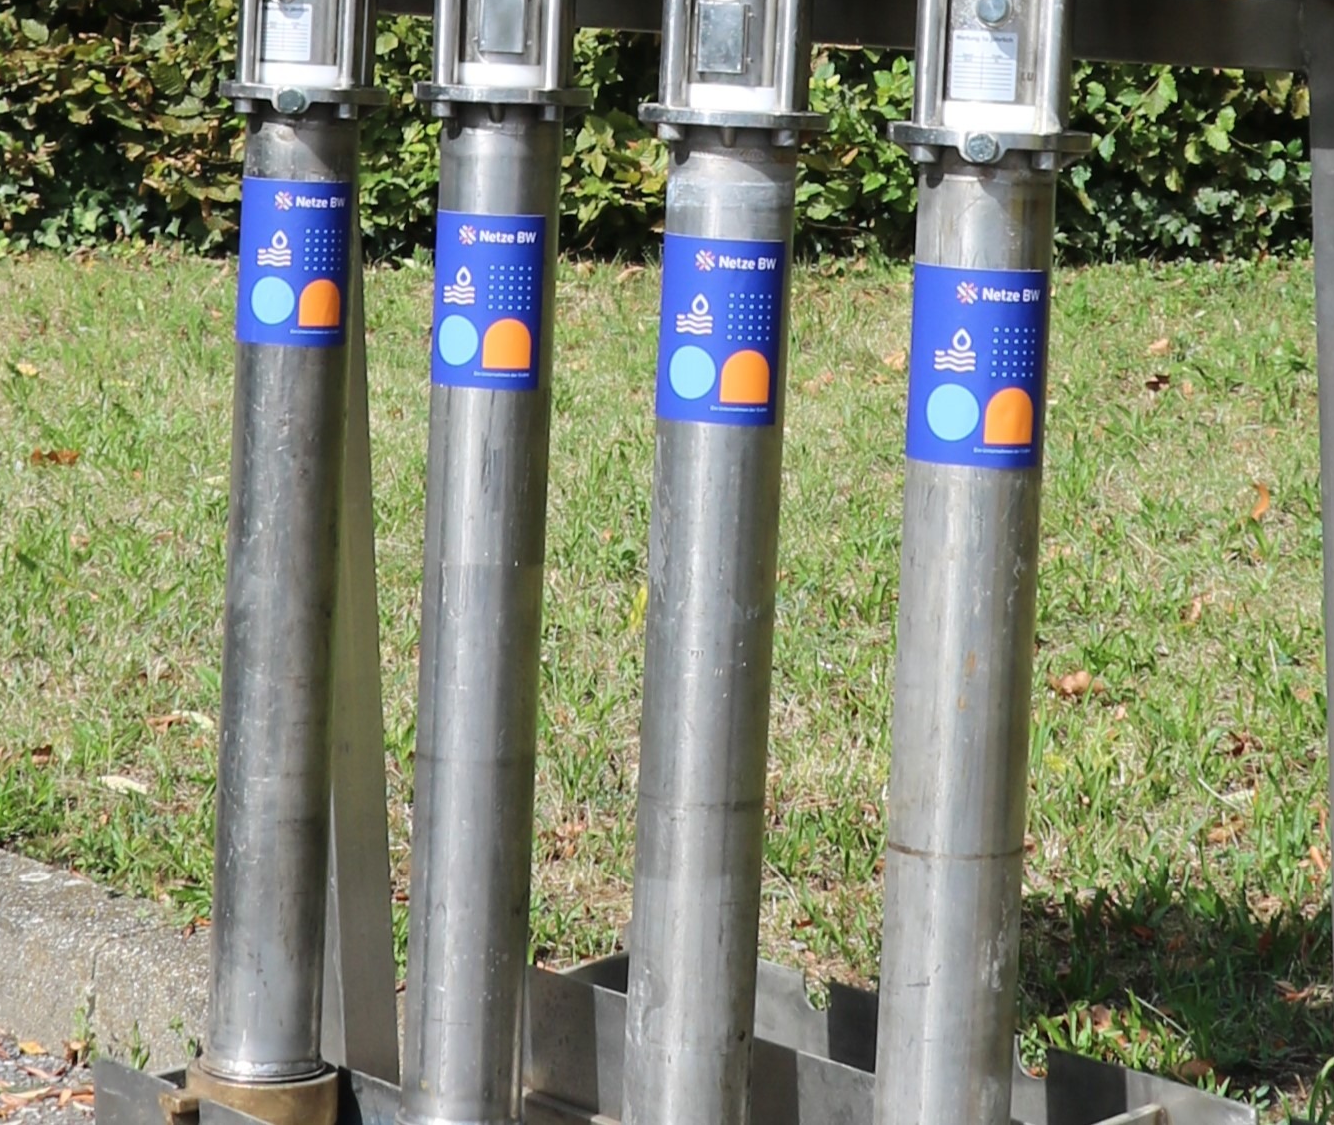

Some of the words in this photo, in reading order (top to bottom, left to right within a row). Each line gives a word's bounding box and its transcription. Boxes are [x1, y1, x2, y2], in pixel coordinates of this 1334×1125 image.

[295, 195, 328, 209] Netze
[329, 196, 346, 209] BW
[479, 229, 515, 244] Netze
[516, 230, 537, 244] BW
[718, 254, 756, 271] Netze
[757, 256, 777, 271] BW
[982, 286, 1021, 303] Netze
[1022, 288, 1042, 303] BW
